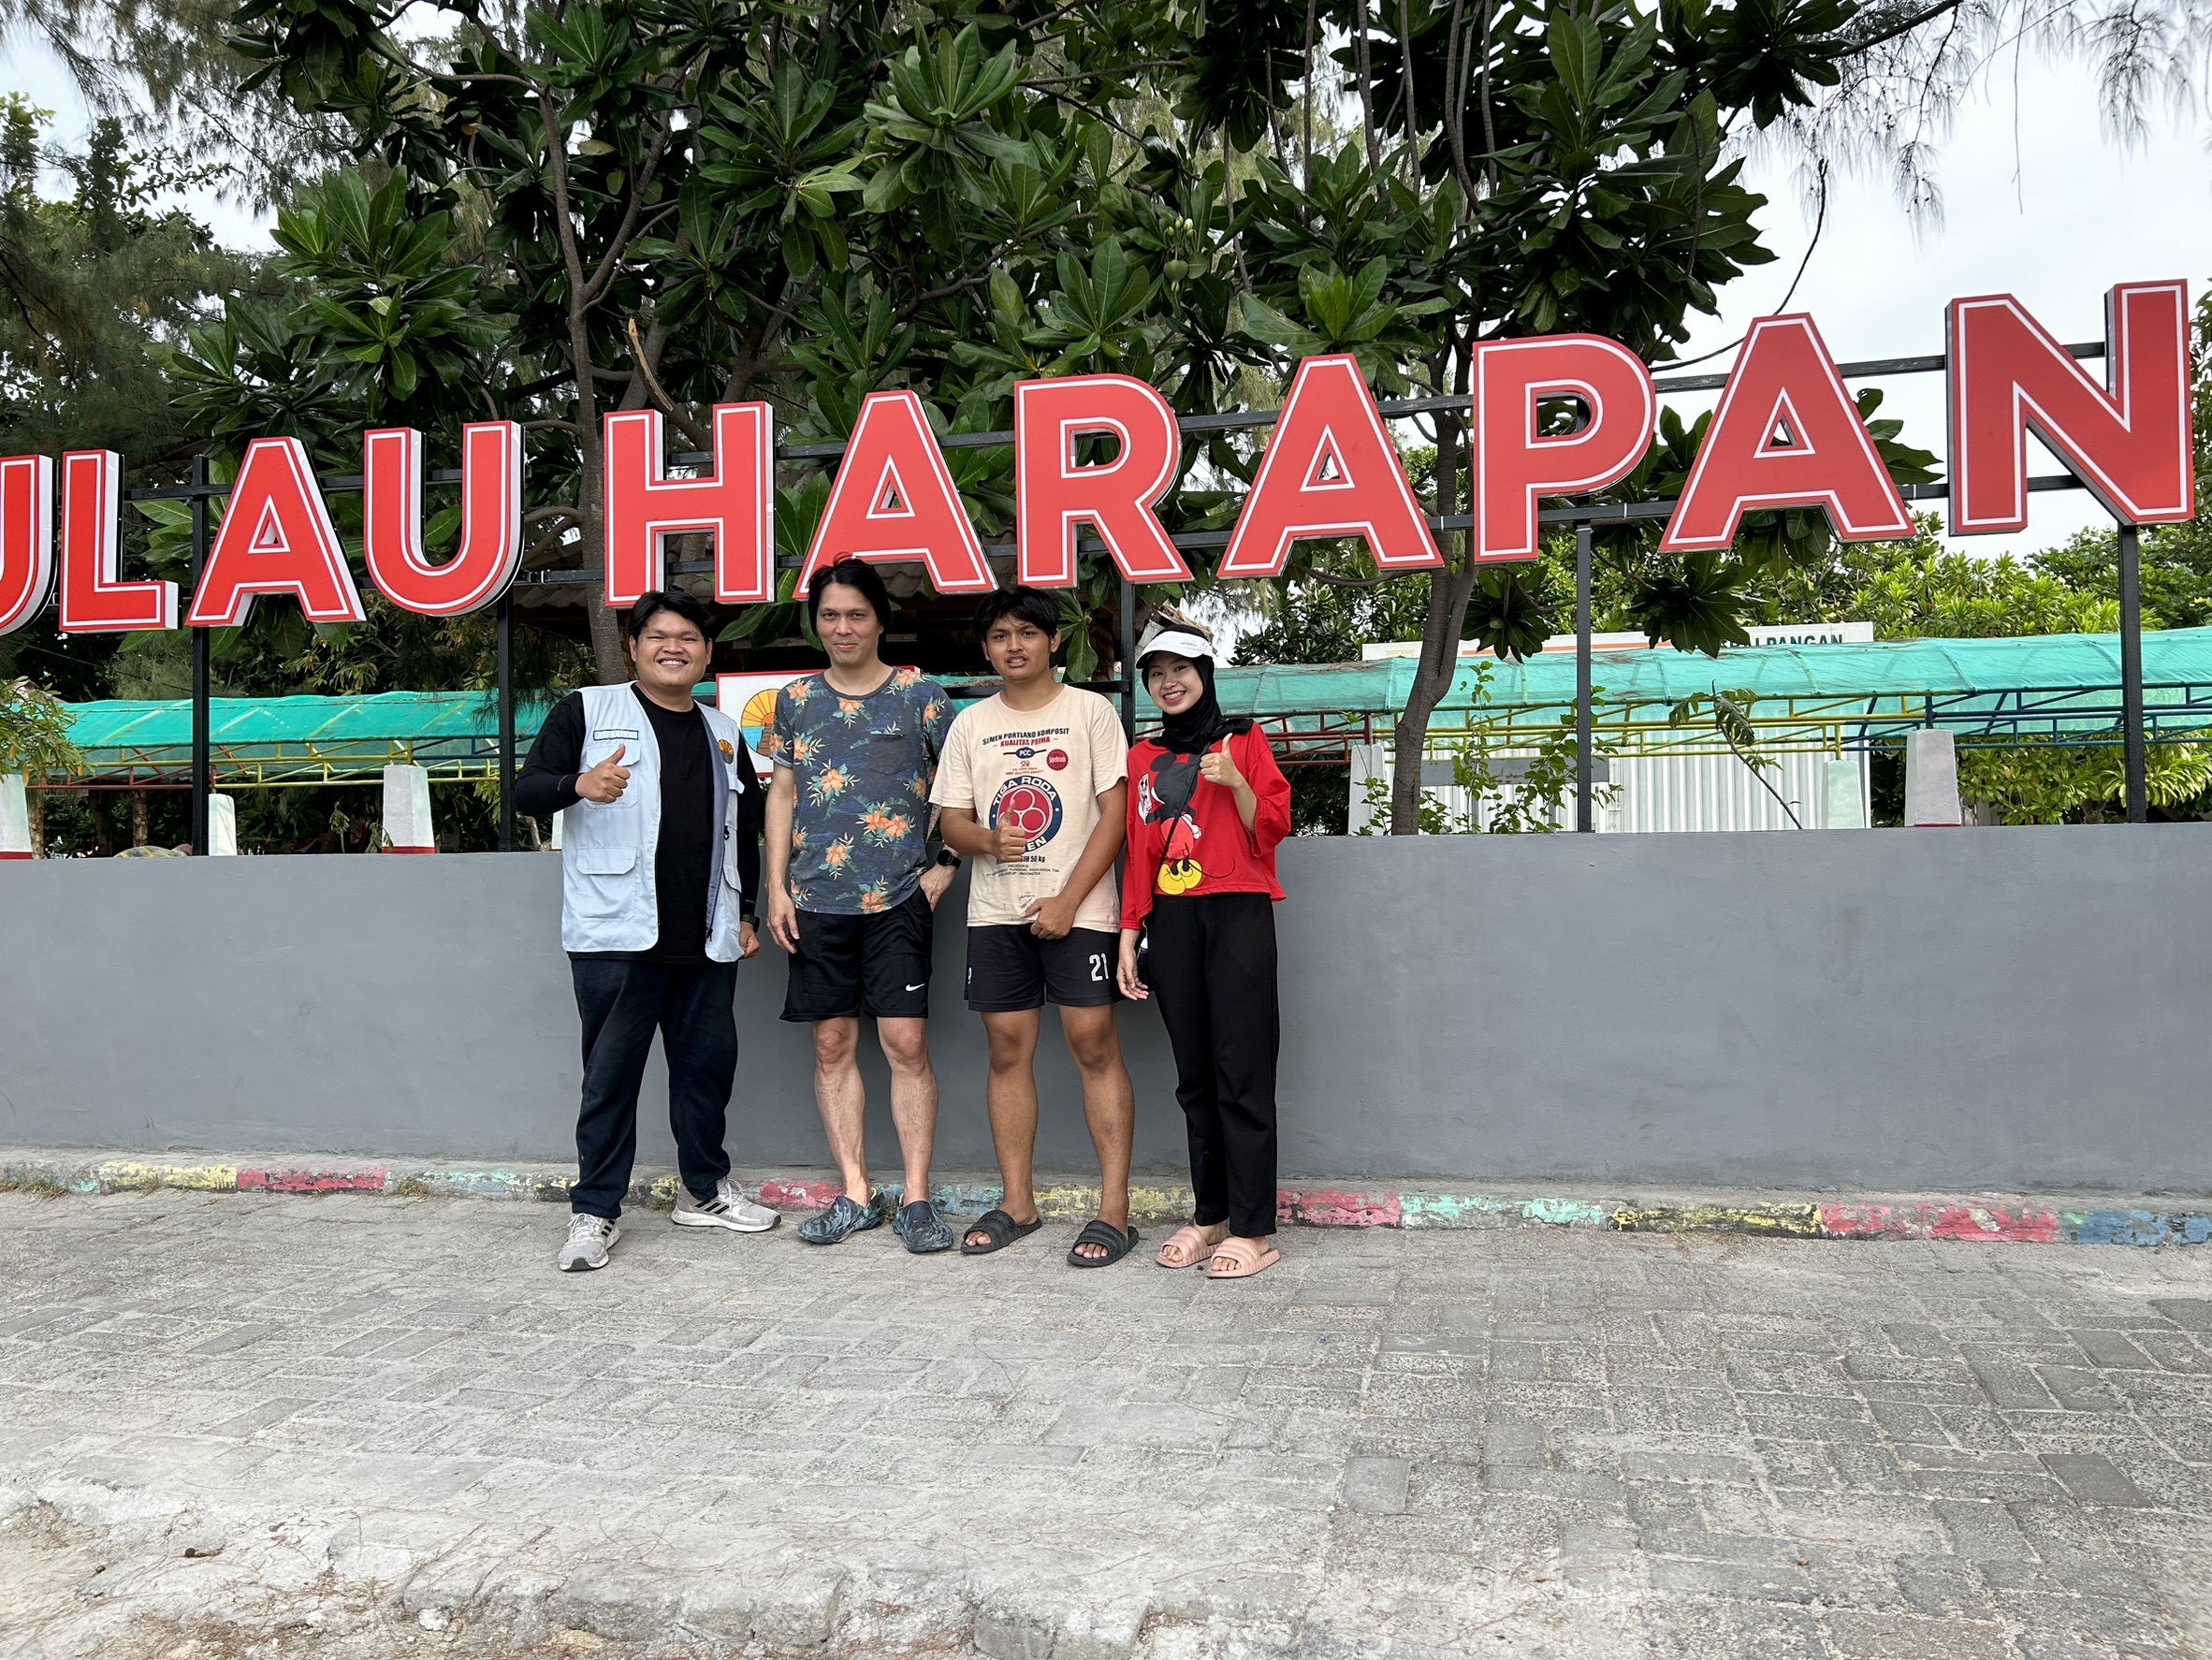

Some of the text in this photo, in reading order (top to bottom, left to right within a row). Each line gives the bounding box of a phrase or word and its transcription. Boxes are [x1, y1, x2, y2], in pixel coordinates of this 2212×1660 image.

[604, 278, 2194, 606] HARAPAN
[982, 728, 1070, 746] SEMEN PORTLAND KOMPOSIT
[1000, 736, 1051, 748] KUALITAS PRIMA
[993, 776, 1057, 806] TIGA RODA
[1088, 953, 1110, 982] 21
